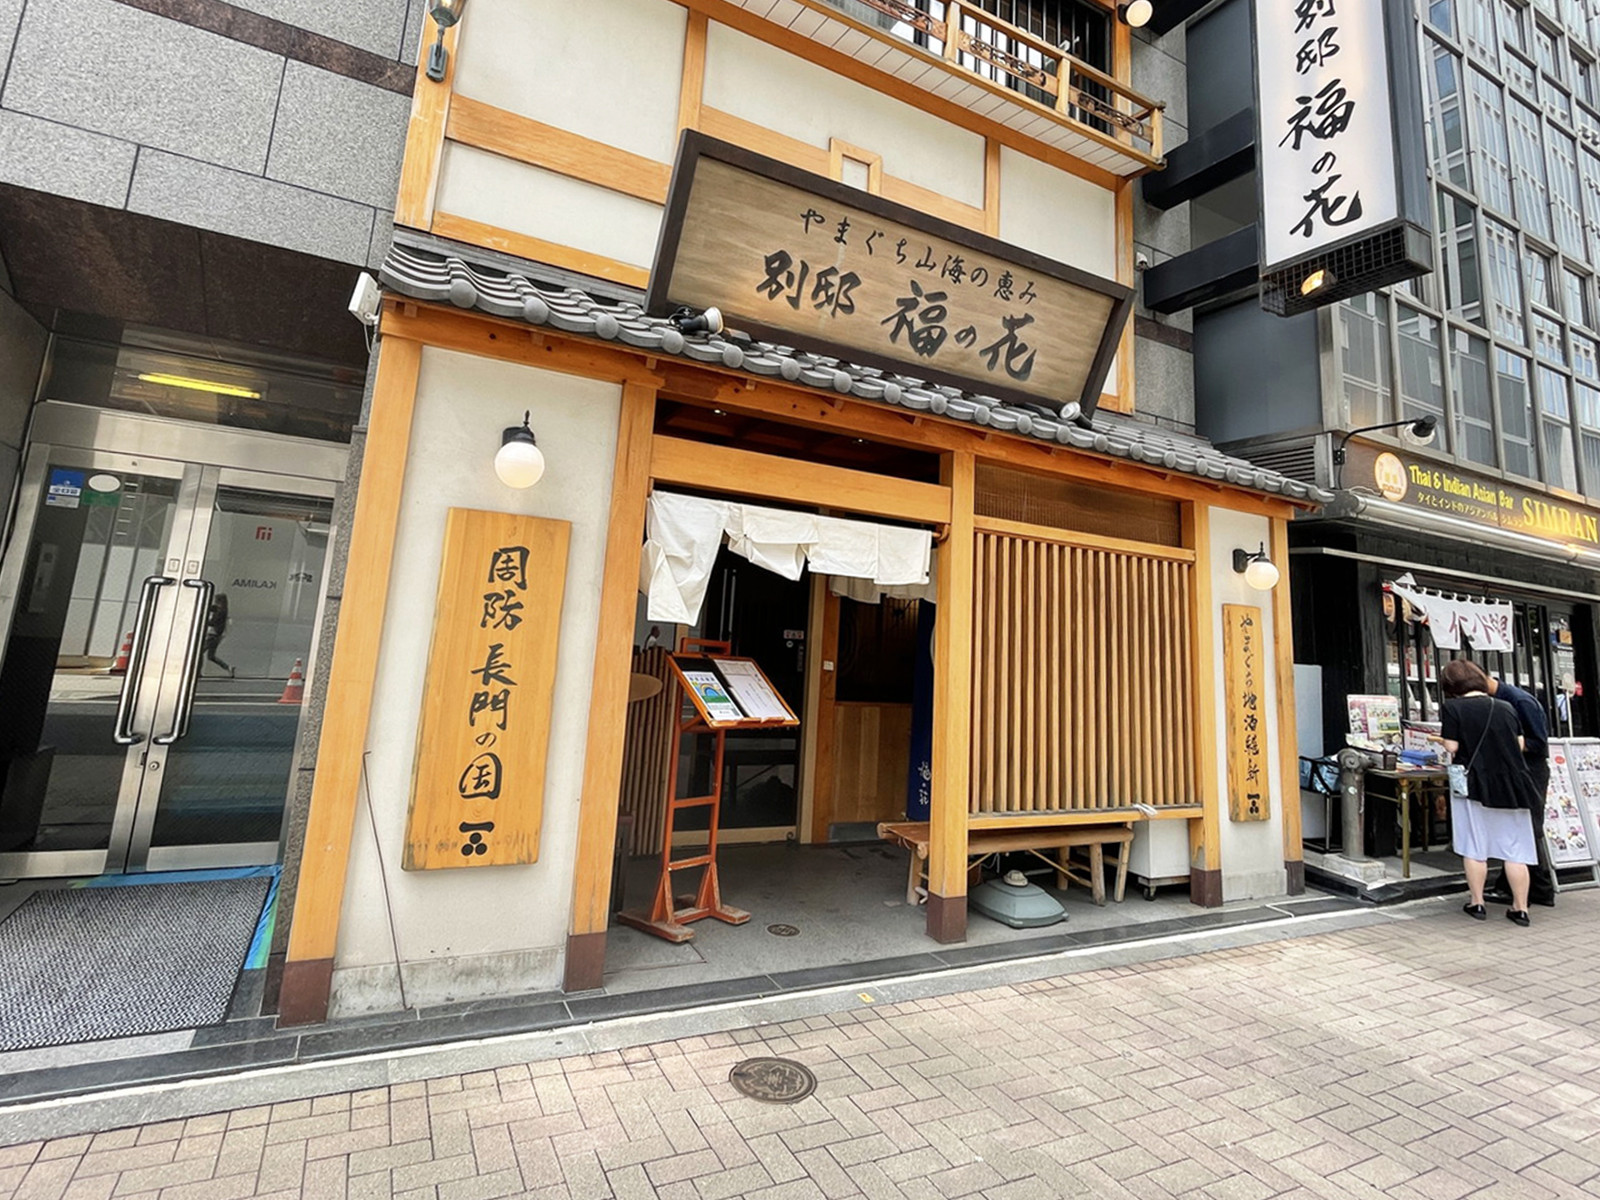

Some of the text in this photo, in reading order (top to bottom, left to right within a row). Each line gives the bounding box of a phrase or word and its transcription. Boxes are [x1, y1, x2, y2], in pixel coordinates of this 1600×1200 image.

[1278, 78, 1363, 239] 福の花
[800, 208, 1037, 304] やまぐち山海の恵み
[756, 250, 1037, 382] 別邸 福の花
[1408, 464, 1432, 488] Thai
[1442, 473, 1472, 499] Indian
[1472, 482, 1497, 506] Asian
[1498, 489, 1514, 510] Bar
[1523, 497, 1598, 543] SIMRAN
[458, 545, 530, 800] 周防 長門の国
